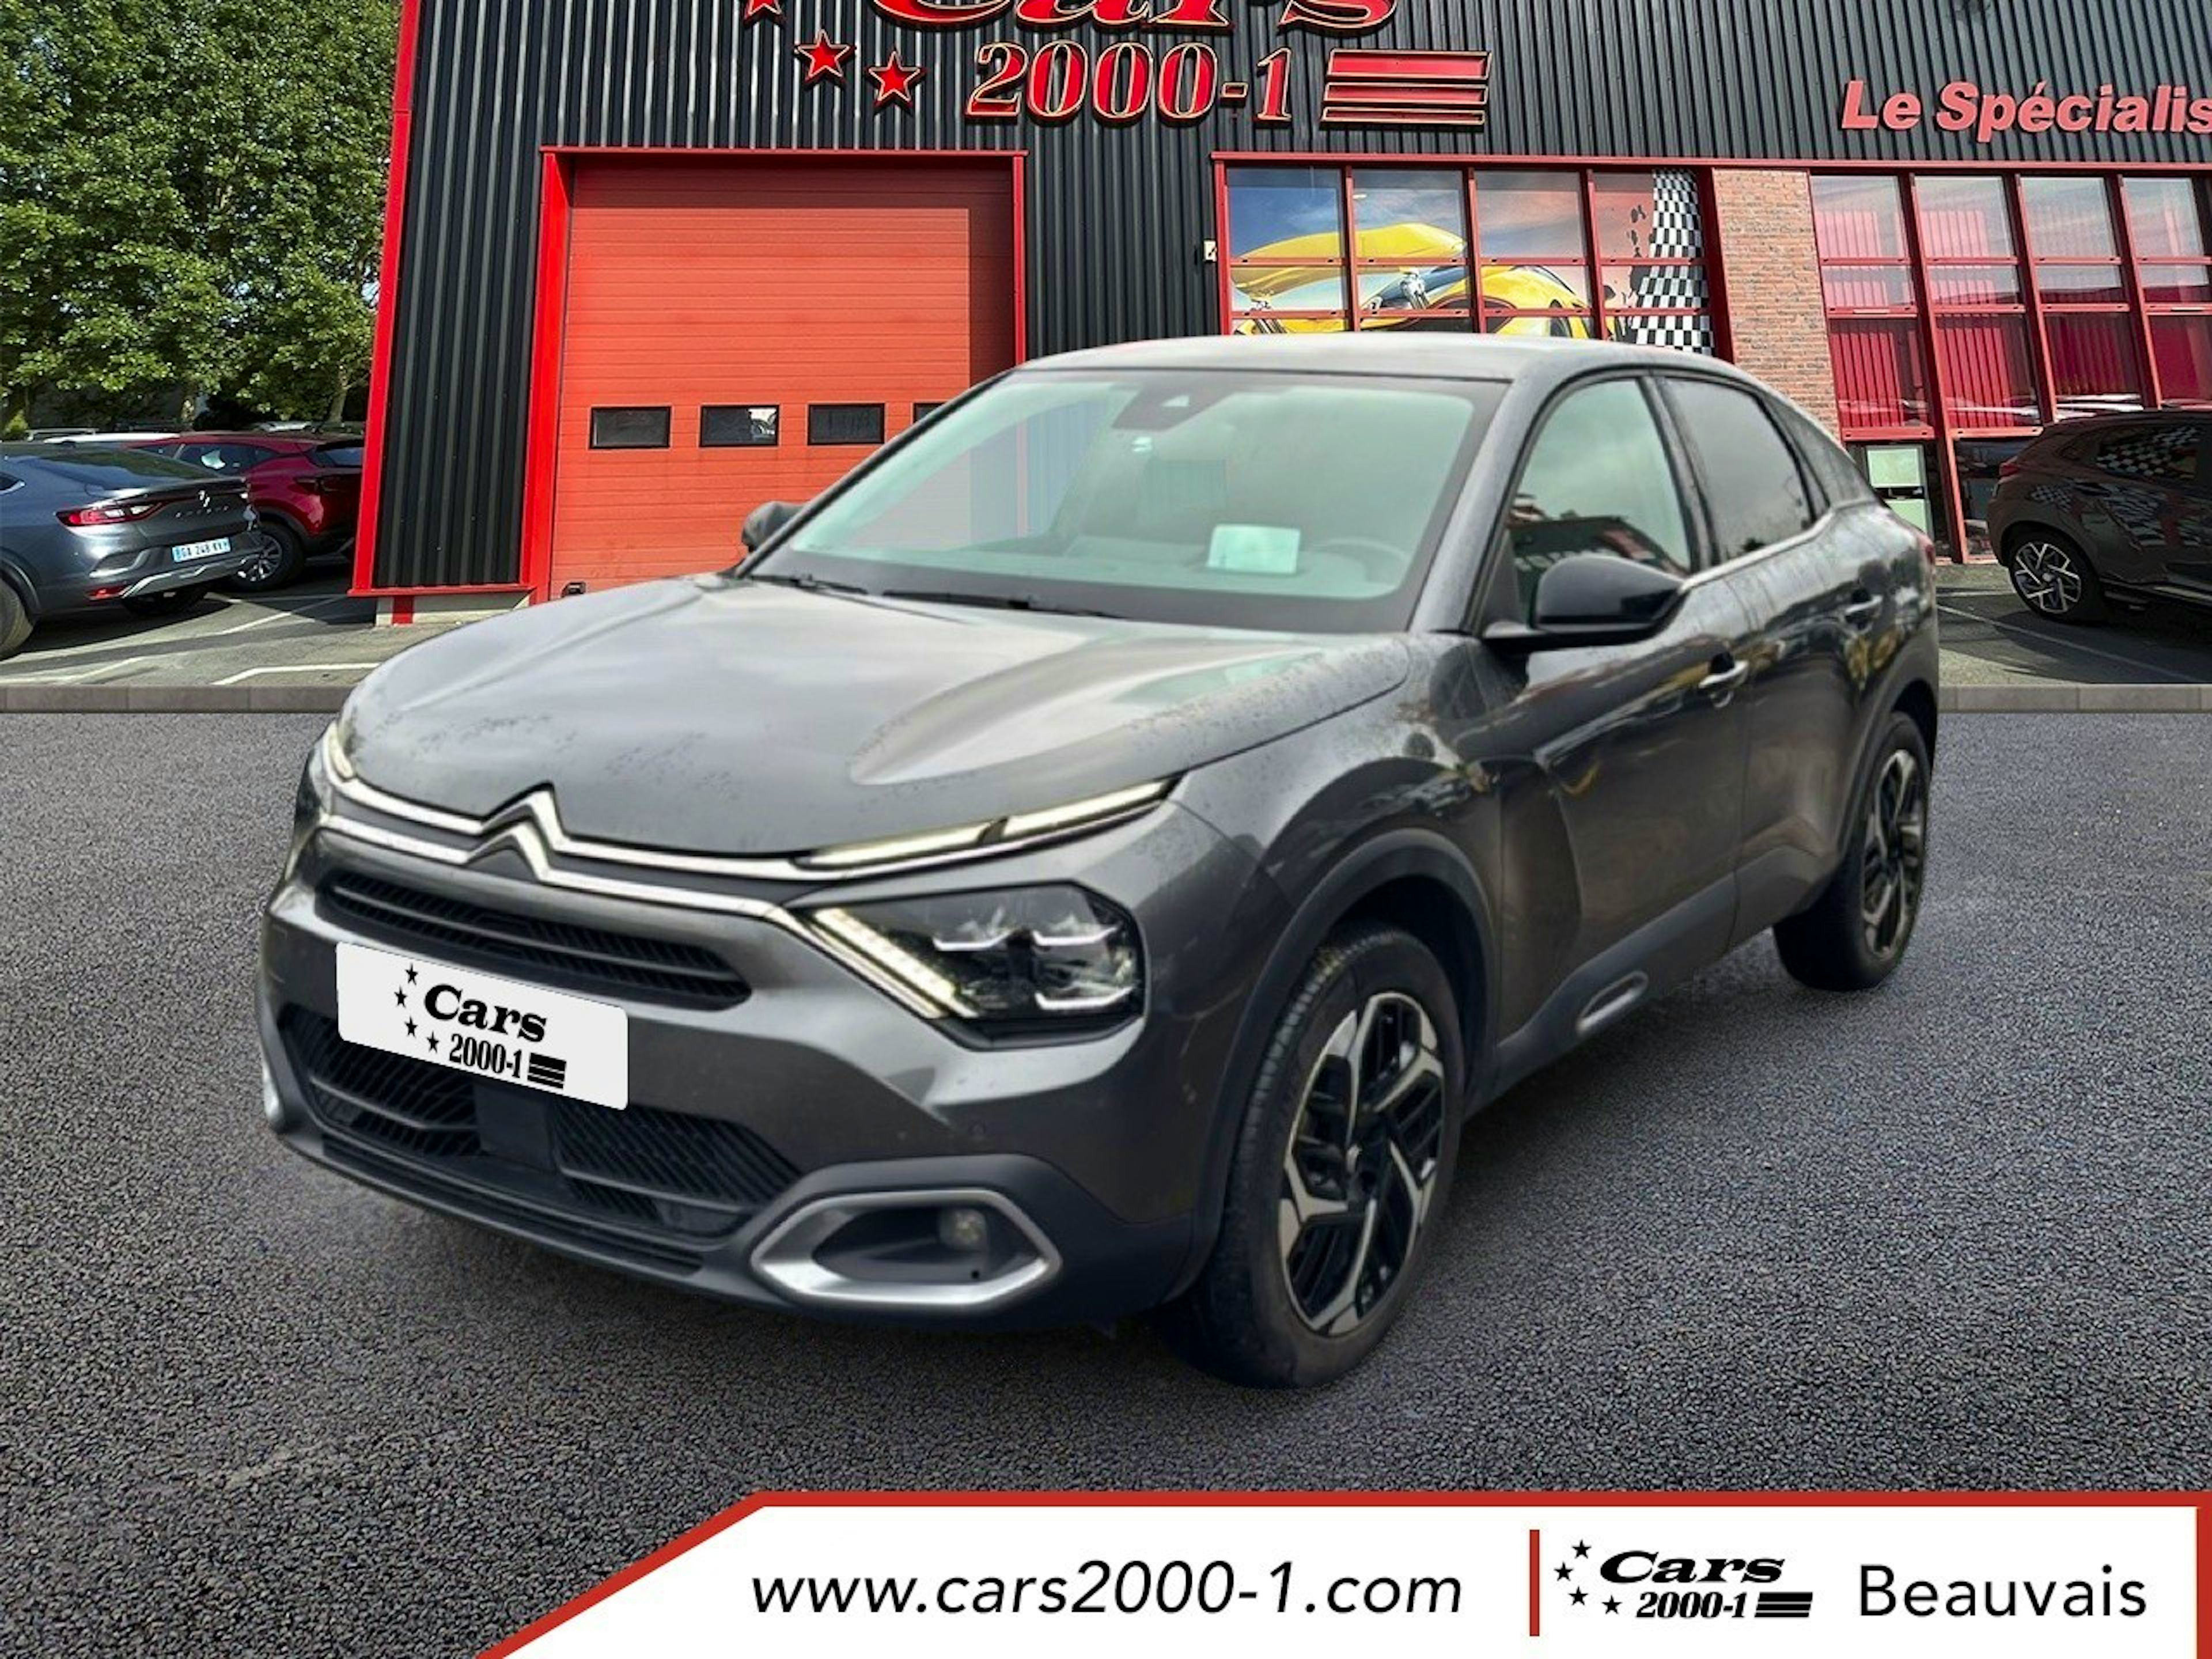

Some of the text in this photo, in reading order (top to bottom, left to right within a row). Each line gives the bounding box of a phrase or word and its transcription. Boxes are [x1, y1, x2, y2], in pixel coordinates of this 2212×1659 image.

[966, 40, 1292, 121] 2000-1
[1842, 79, 1921, 130] Le
[425, 984, 547, 1042] Cars
[449, 1034, 522, 1078] 2000-1
